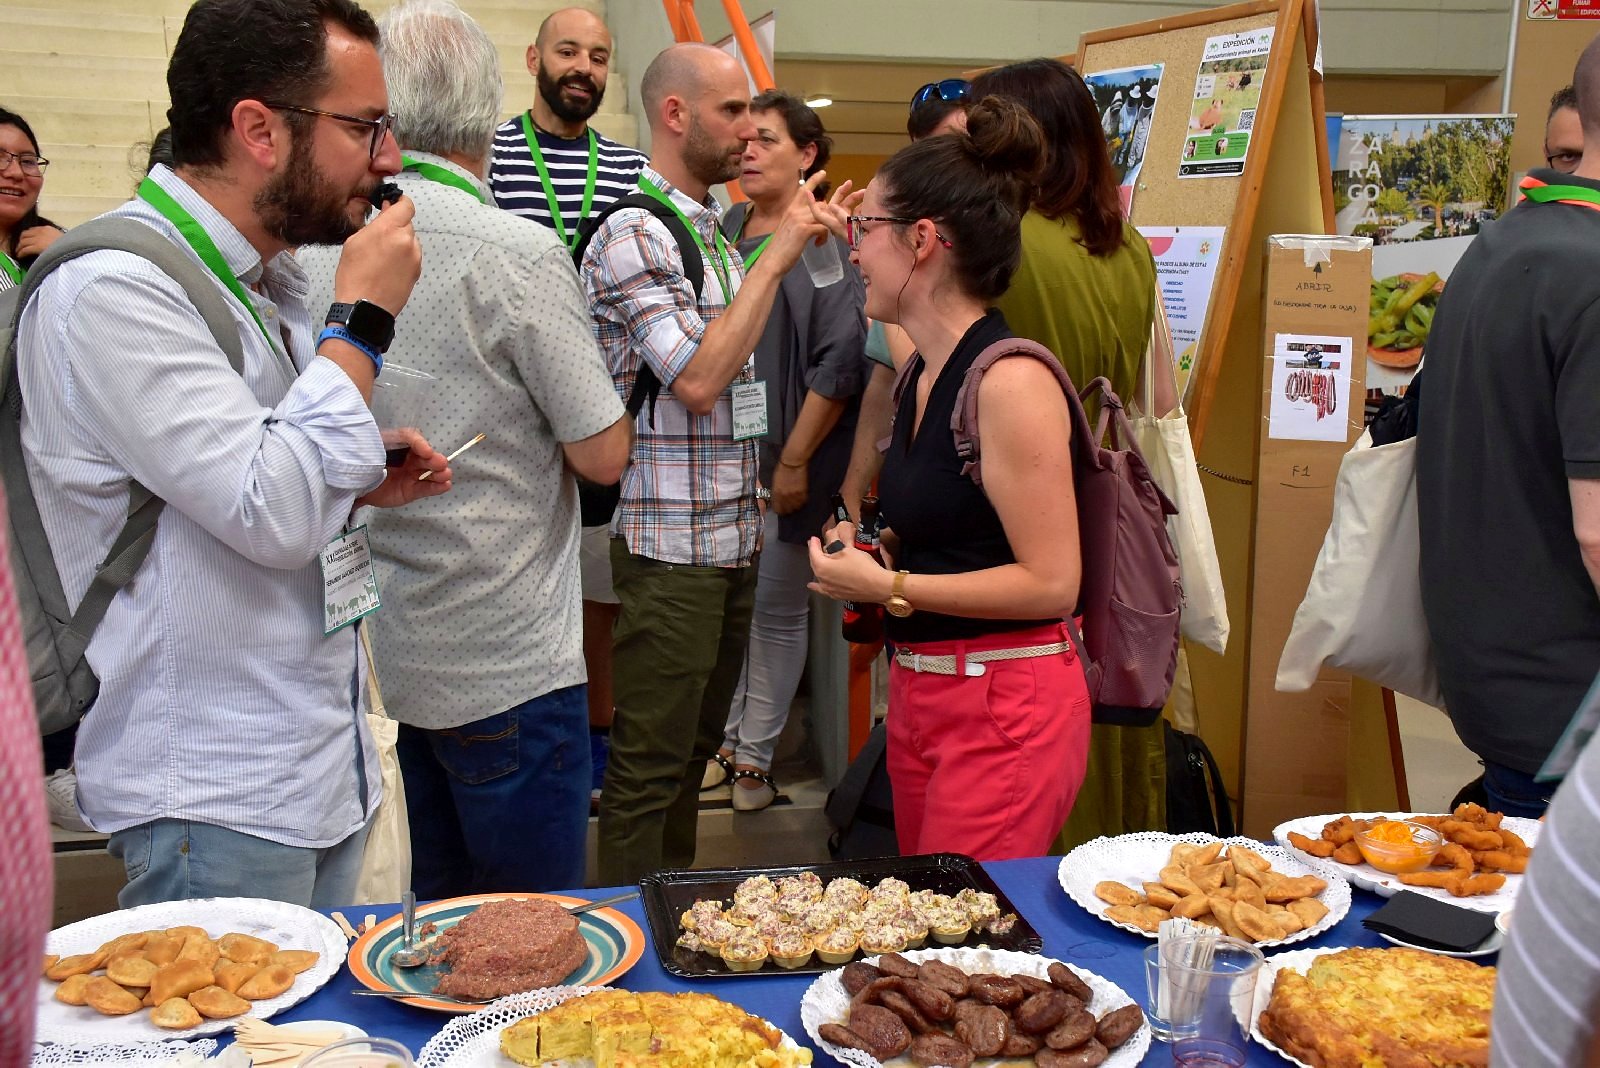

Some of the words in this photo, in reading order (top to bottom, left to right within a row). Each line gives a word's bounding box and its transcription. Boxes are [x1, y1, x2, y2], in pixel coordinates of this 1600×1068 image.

[1222, 36, 1256, 49] EXPEDICIÓN
[1296, 282, 1334, 292] ABRIR
[1292, 466, 1311, 477] F1
